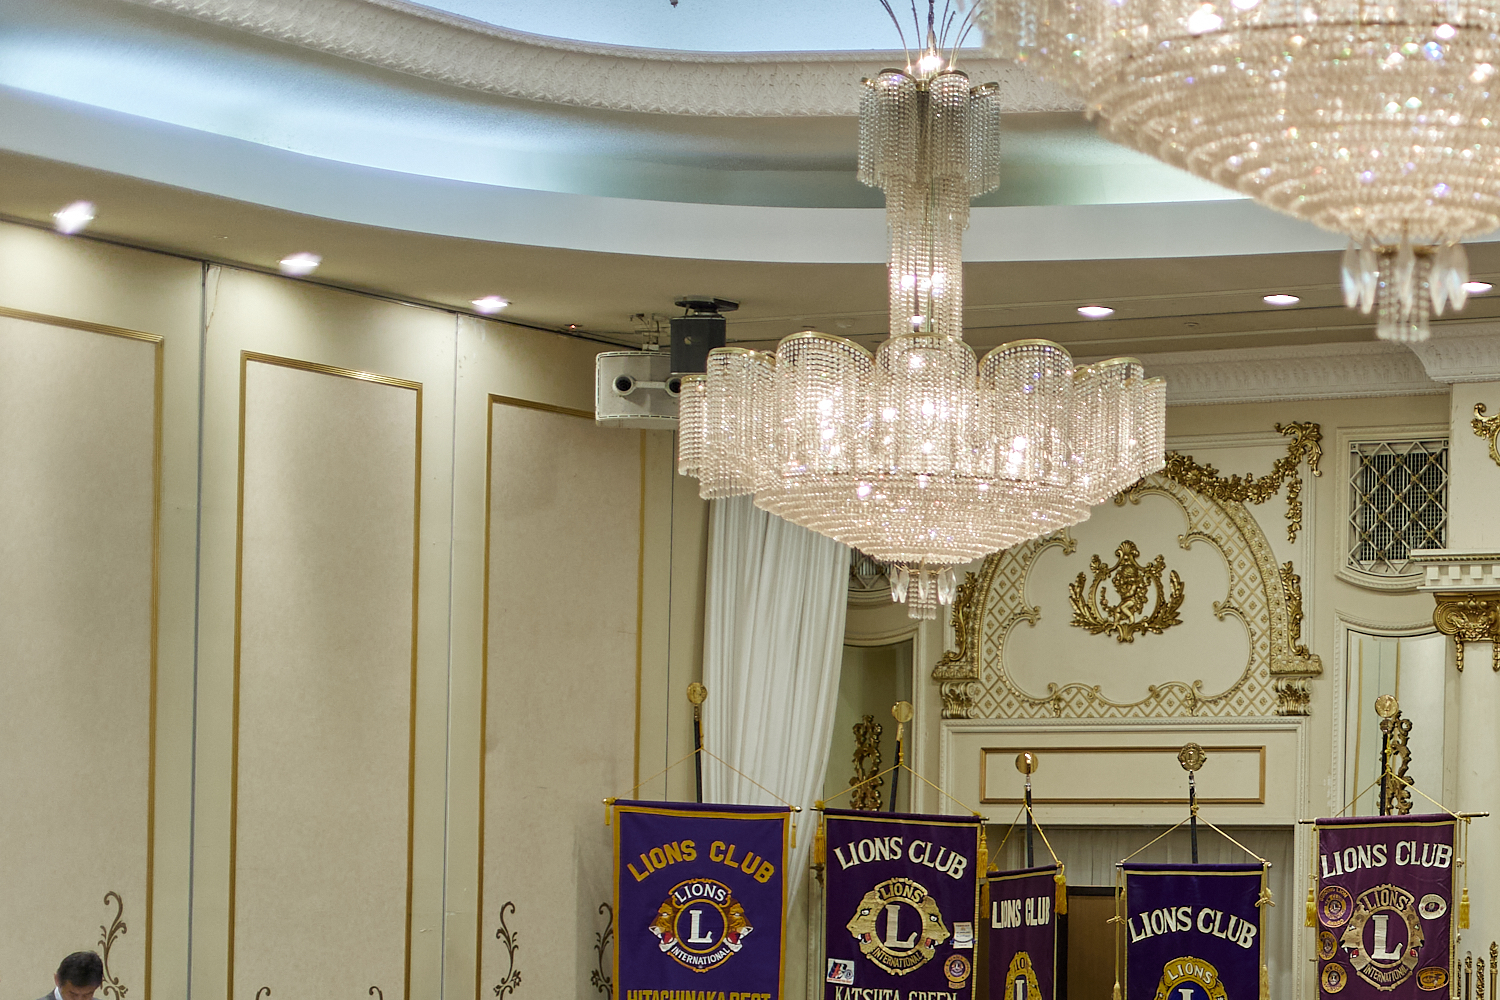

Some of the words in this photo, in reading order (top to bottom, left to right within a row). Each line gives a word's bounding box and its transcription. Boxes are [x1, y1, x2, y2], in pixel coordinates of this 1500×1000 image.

[627, 840, 697, 882] LIONS
[709, 840, 775, 883] CLUB
[833, 836, 903, 871] LIONS
[908, 839, 968, 880] CLUB
[1320, 843, 1388, 879] LIONS
[1395, 840, 1453, 868] CLUB
[674, 883, 726, 903] LIONS
[880, 882, 924, 903] LIONS
[1362, 889, 1408, 911] LIONS
[688, 910, 713, 943] L
[884, 904, 918, 949] L
[991, 898, 1021, 929] LIONS
[1025, 896, 1051, 927] CLUB
[1127, 906, 1192, 944] LIONS
[1197, 907, 1257, 949] CLUB
[1371, 914, 1403, 960] L
[671, 947, 730, 965] INTERNATIONAL
[871, 947, 924, 968] INTERNATIONAL
[1166, 962, 1213, 984] LIONS
